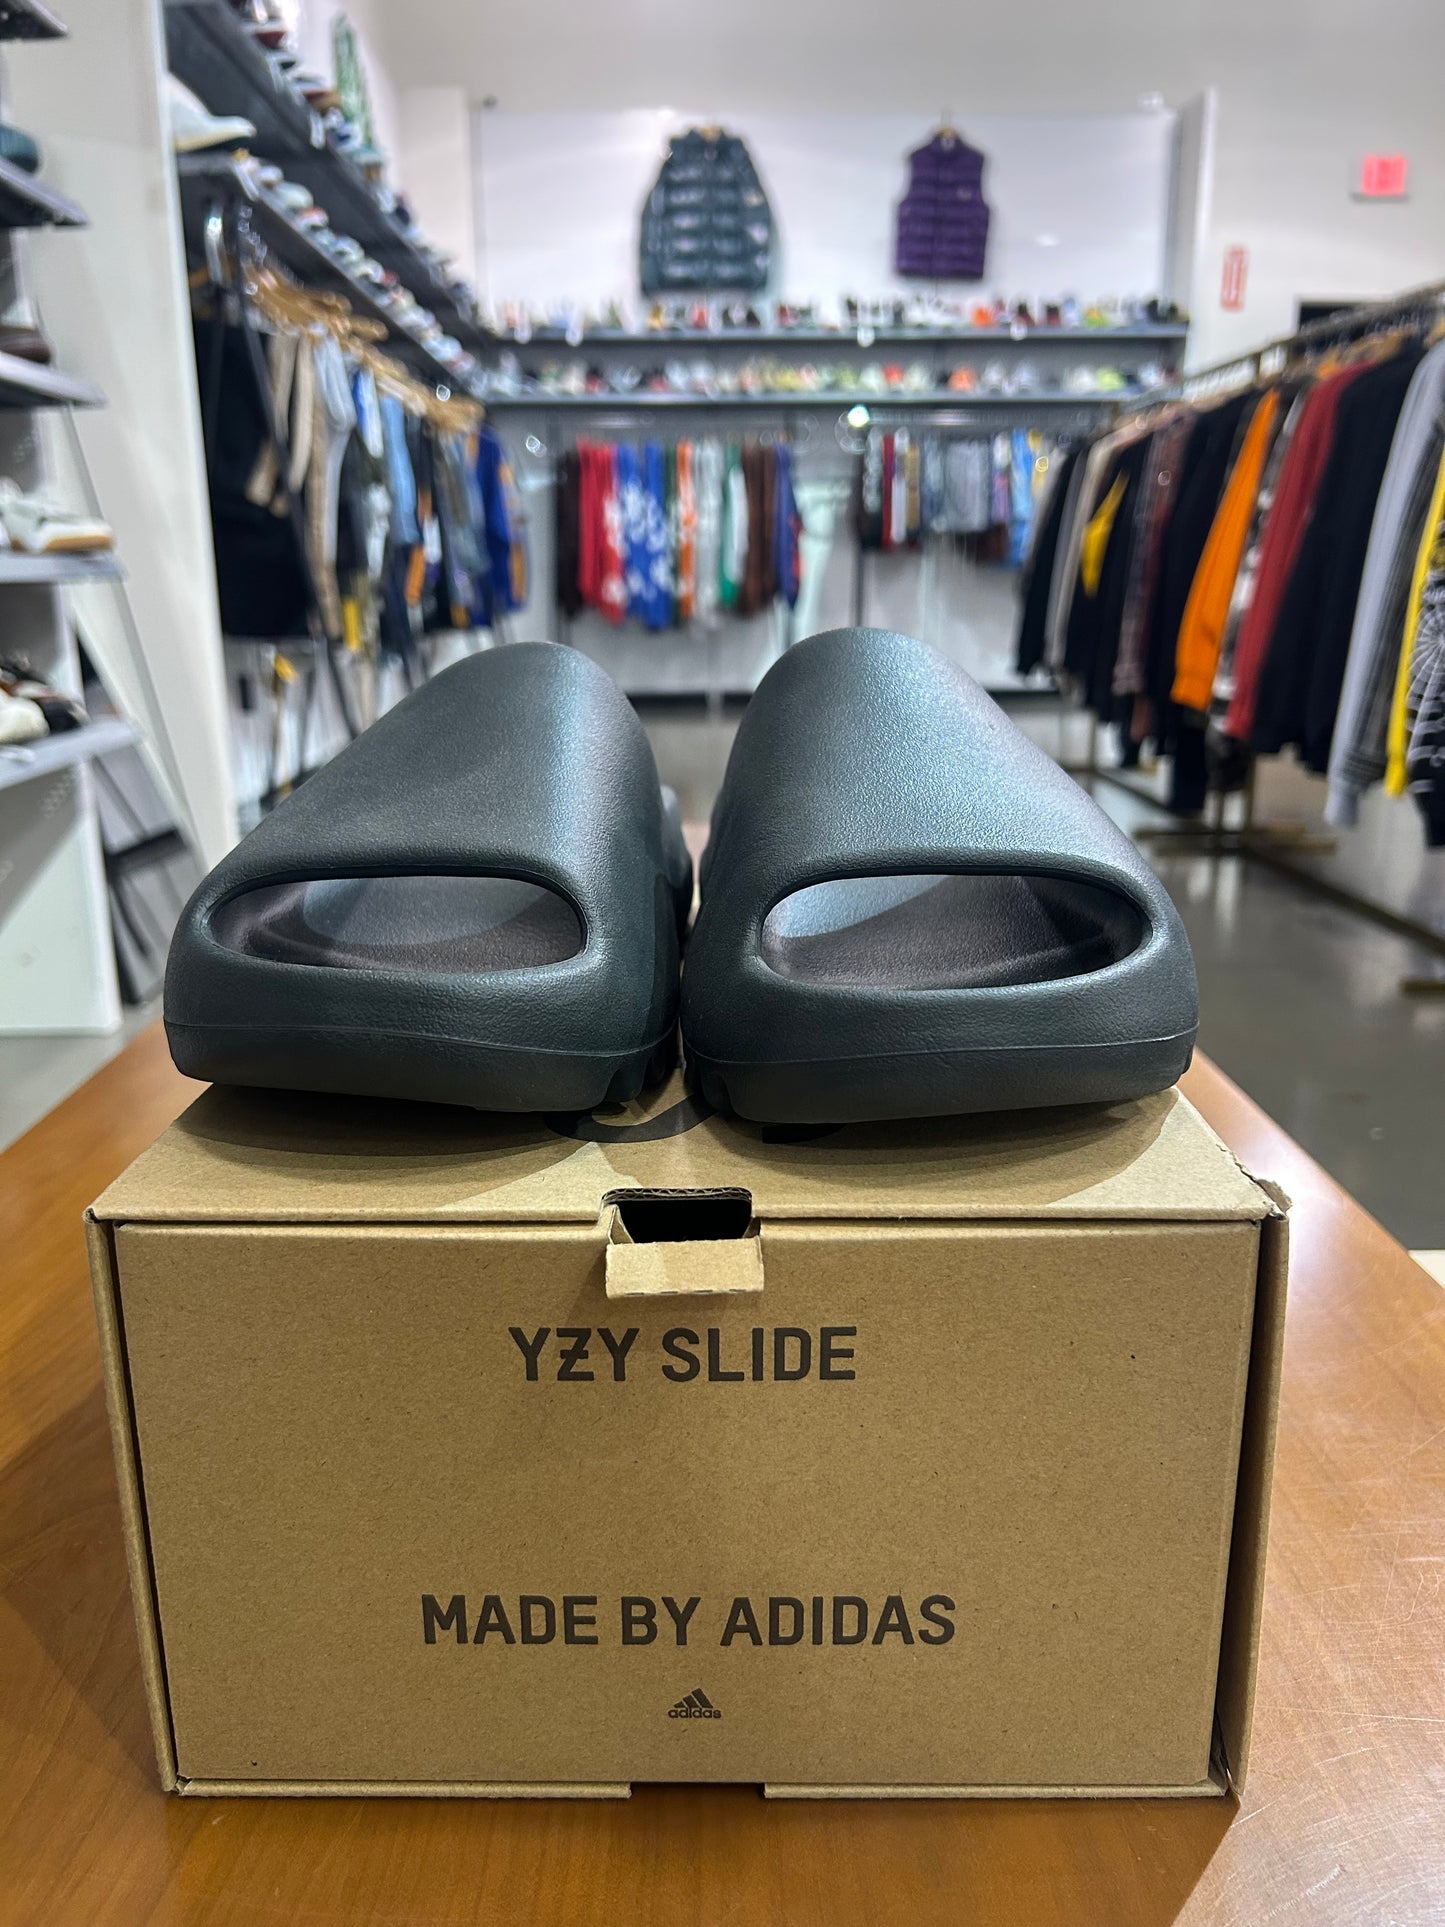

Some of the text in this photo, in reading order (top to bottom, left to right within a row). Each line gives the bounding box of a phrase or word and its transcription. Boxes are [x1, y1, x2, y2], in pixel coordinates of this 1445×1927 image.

[661, 1326, 857, 1383] SLIDE
[422, 1594, 955, 1647] MADE BY ADIDAS
[668, 1706, 722, 1719] adidas
